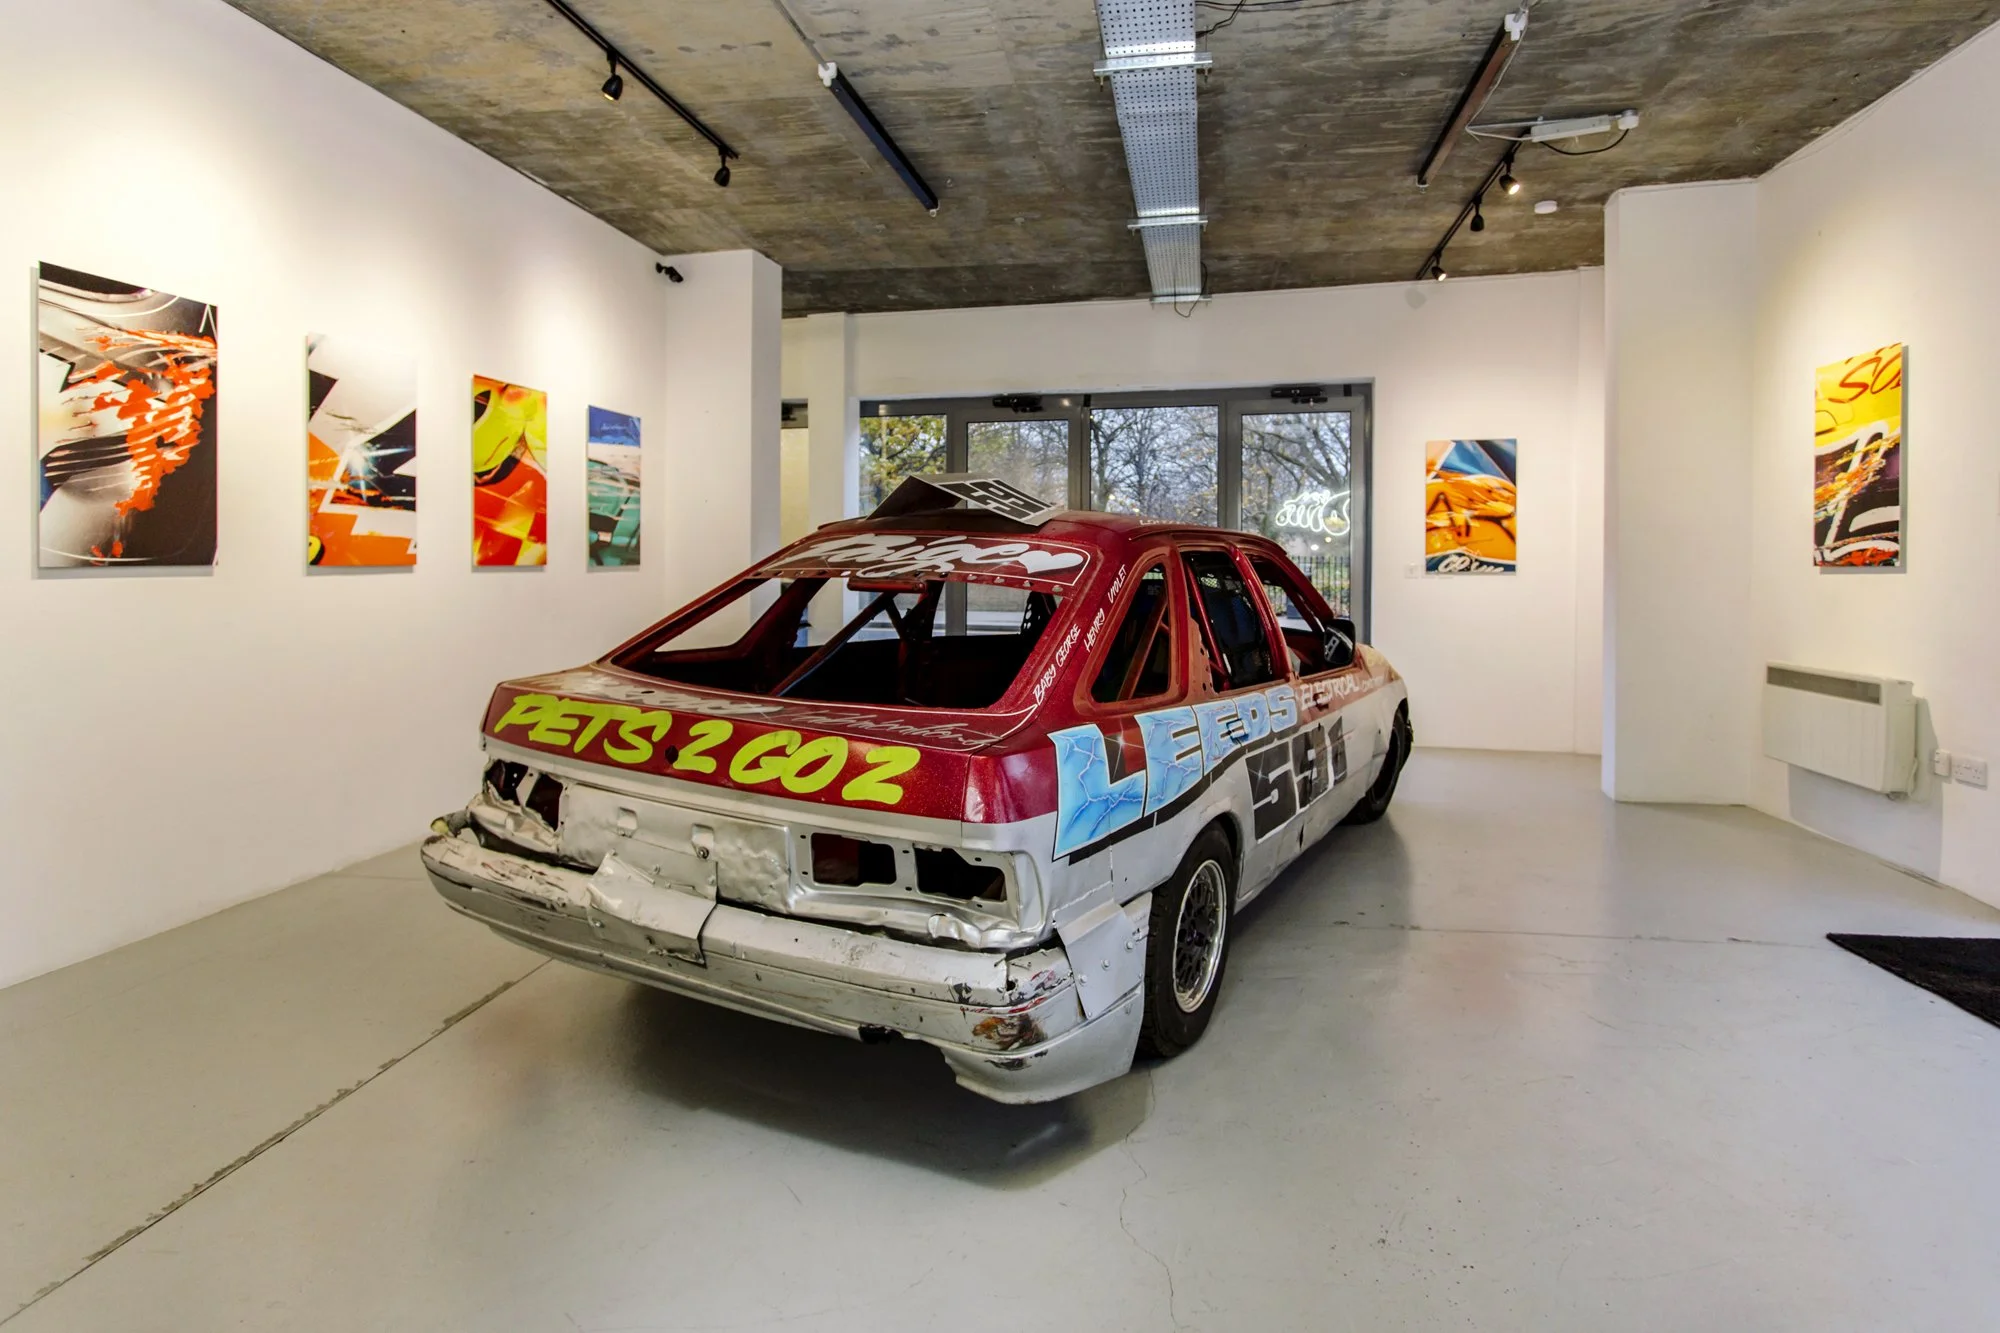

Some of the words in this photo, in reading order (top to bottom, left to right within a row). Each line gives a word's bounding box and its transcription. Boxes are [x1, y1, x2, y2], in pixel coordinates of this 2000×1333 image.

[938, 479, 1053, 520] 591
[762, 533, 1030, 578] Paige
[1083, 607, 1106, 653] HENRY
[1107, 564, 1128, 604] VIOLET
[1033, 663, 1057, 706] BABY
[1055, 623, 1081, 668] GEORGE
[494, 692, 672, 764] PETS
[673, 719, 733, 774] 2
[729, 730, 849, 793] GO
[841, 746, 921, 805] 2
[1046, 684, 1298, 863] LEEDS
